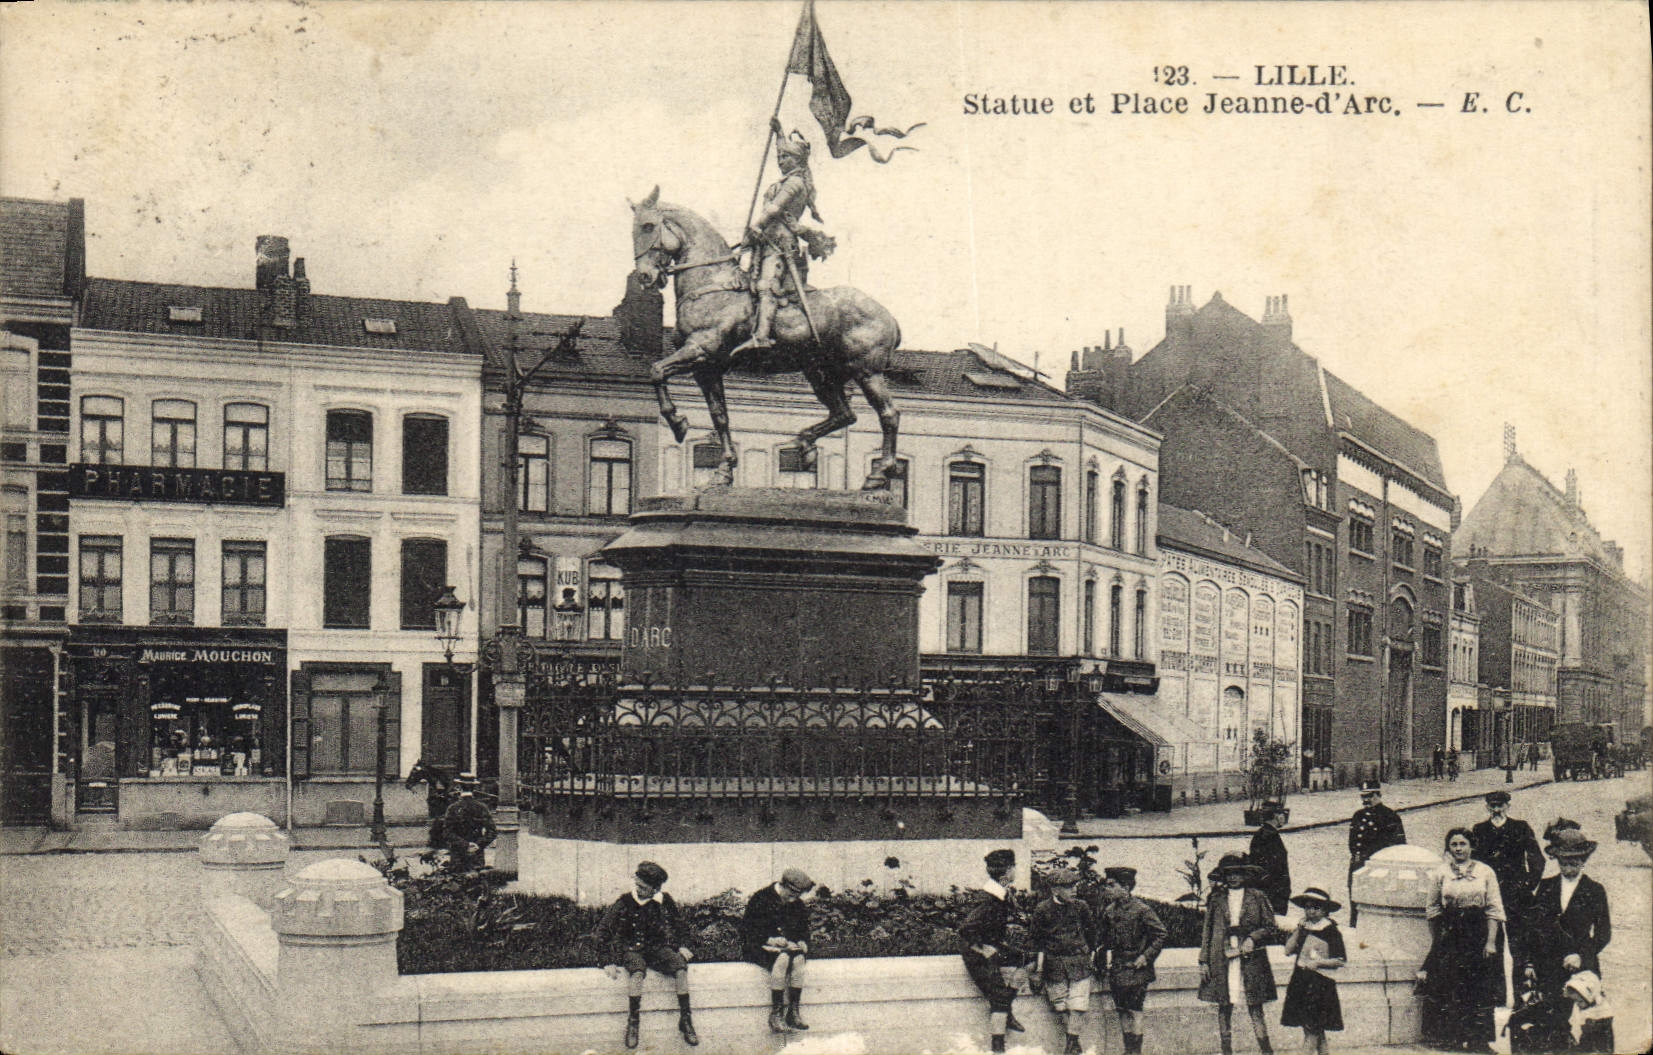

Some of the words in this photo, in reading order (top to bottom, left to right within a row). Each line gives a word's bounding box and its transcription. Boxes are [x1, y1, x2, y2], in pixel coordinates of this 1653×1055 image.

[83, 468, 273, 500] PHARMACIE
[971, 543, 1031, 556] JEANNE
[556, 570, 580, 586] KUB
[140, 649, 187, 663] MAURICE
[192, 650, 272, 664] MOUCHON
